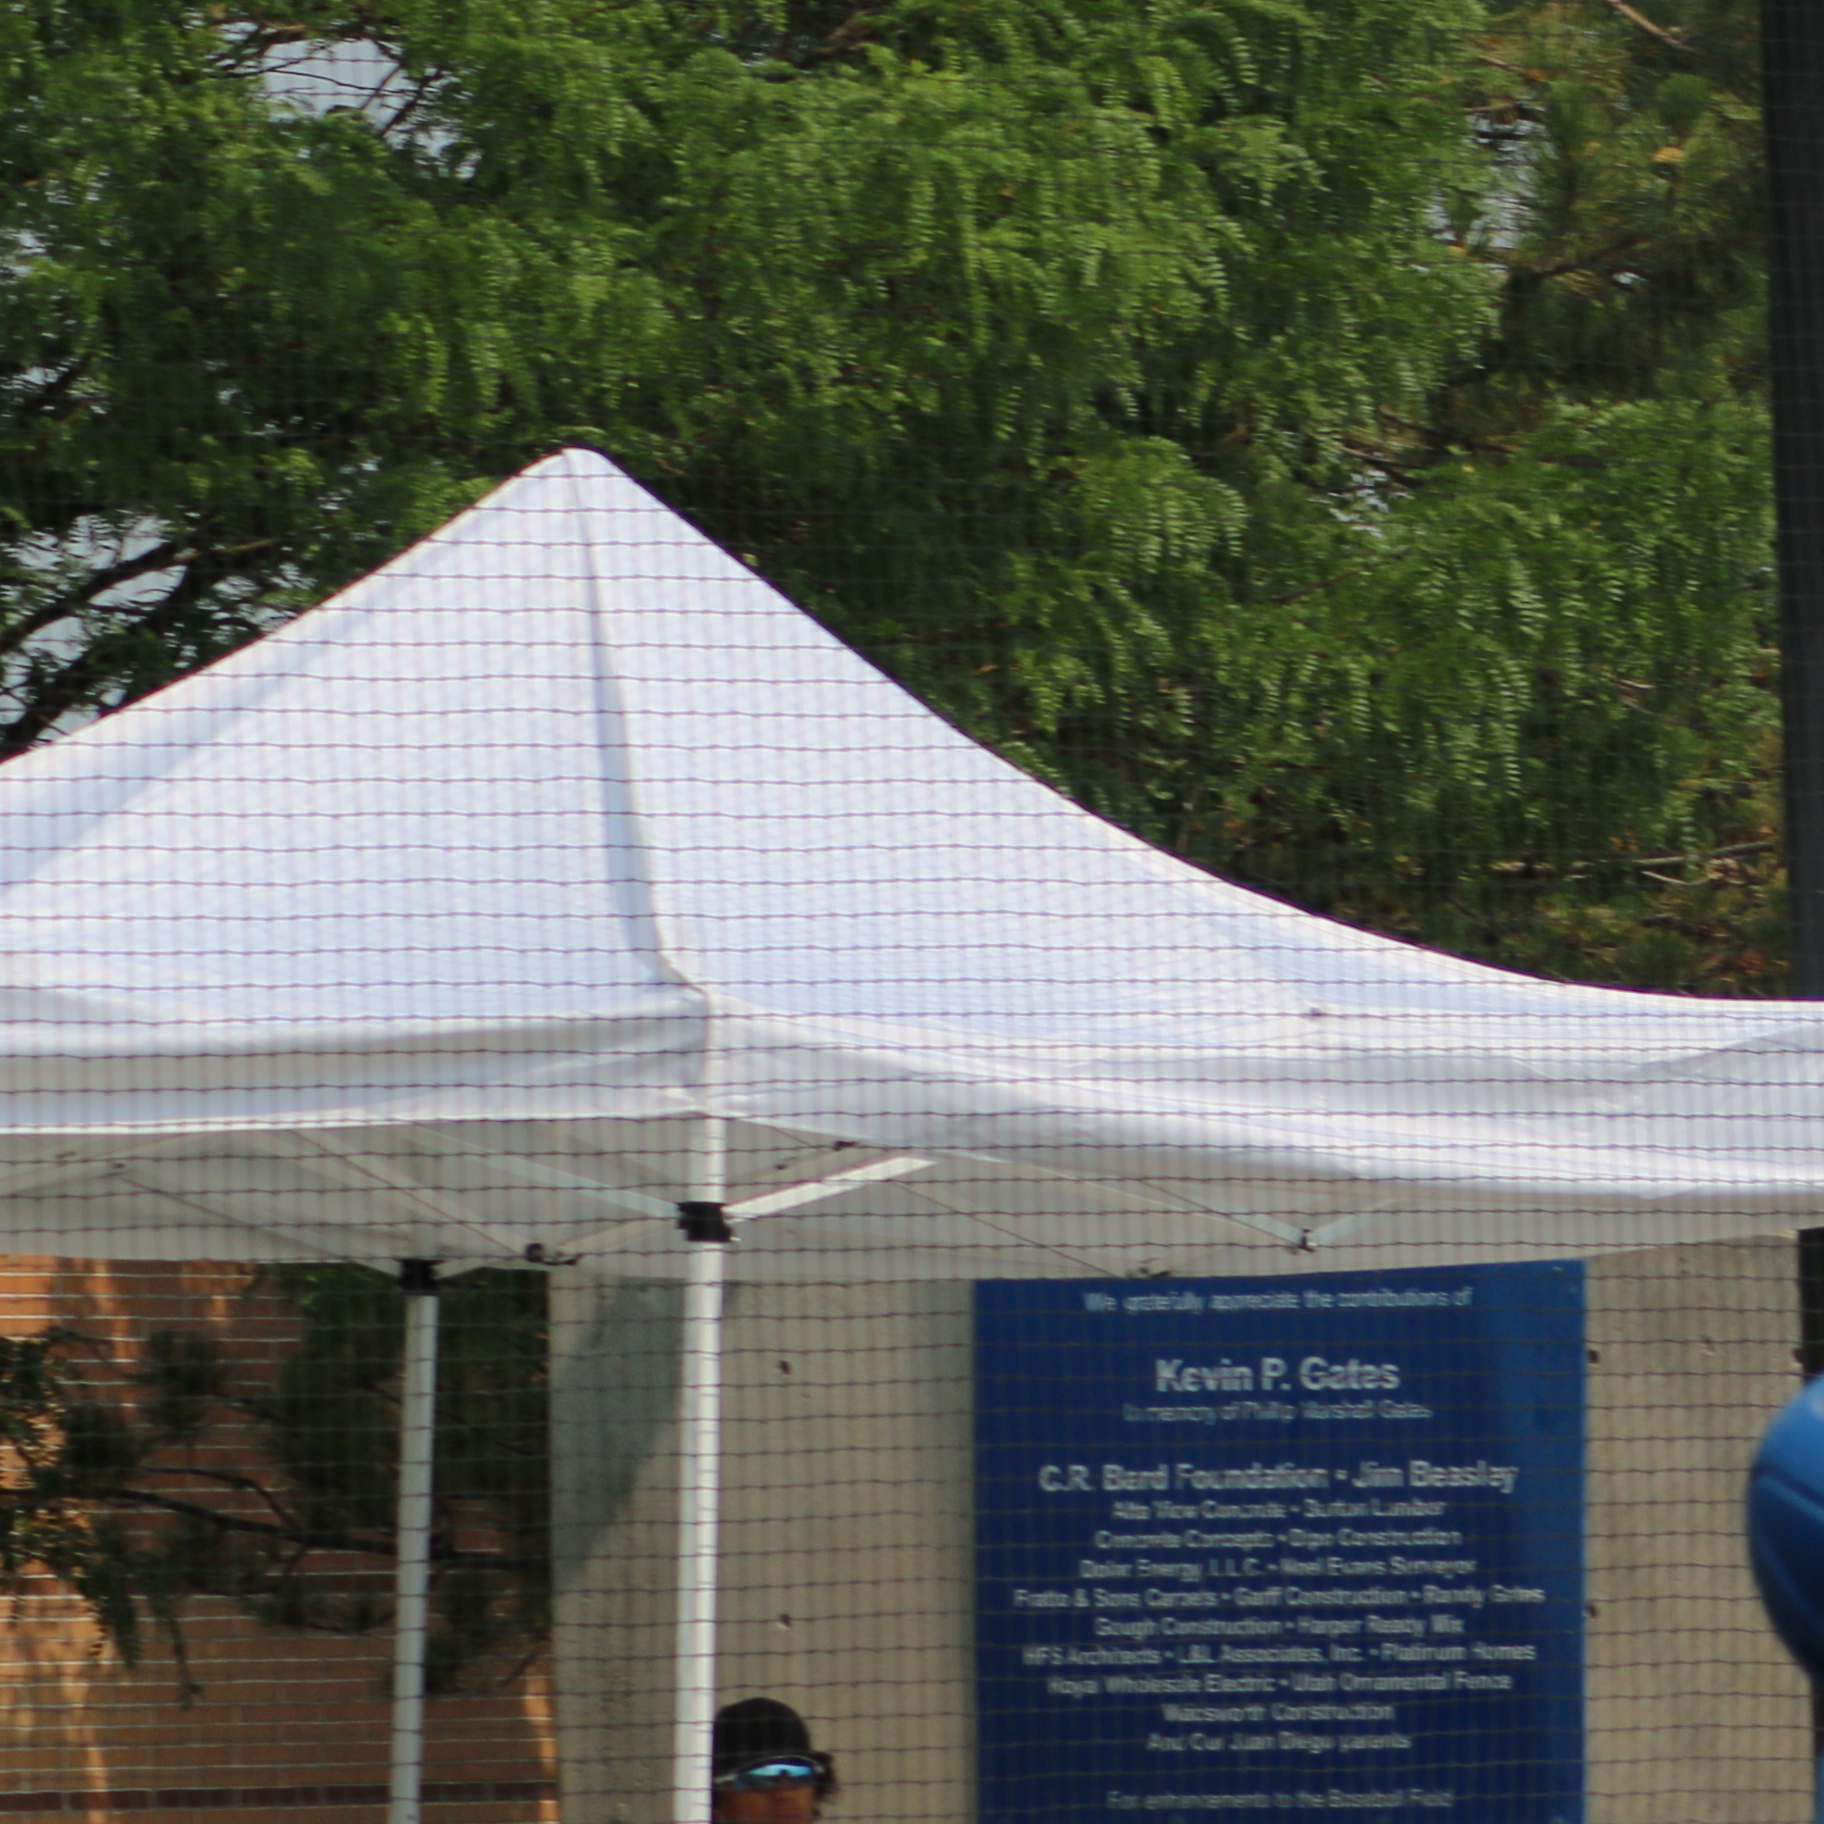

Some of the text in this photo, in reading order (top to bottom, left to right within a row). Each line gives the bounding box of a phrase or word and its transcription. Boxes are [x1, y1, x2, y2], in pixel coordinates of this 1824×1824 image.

[1155, 1355, 1401, 1393] Kevin P. Gates
[1102, 1463, 1169, 1492] Bard
[1175, 1461, 1329, 1491] Foundation
[1350, 1460, 1405, 1489] Jim
[1408, 1459, 1519, 1494] Beasley
[1333, 1526, 1463, 1547] Construction
[1071, 1588, 1091, 1608] &
[1283, 1585, 1411, 1607] Construction
[1157, 1616, 1285, 1637] Construction
[1270, 1701, 1396, 1722] Construction
